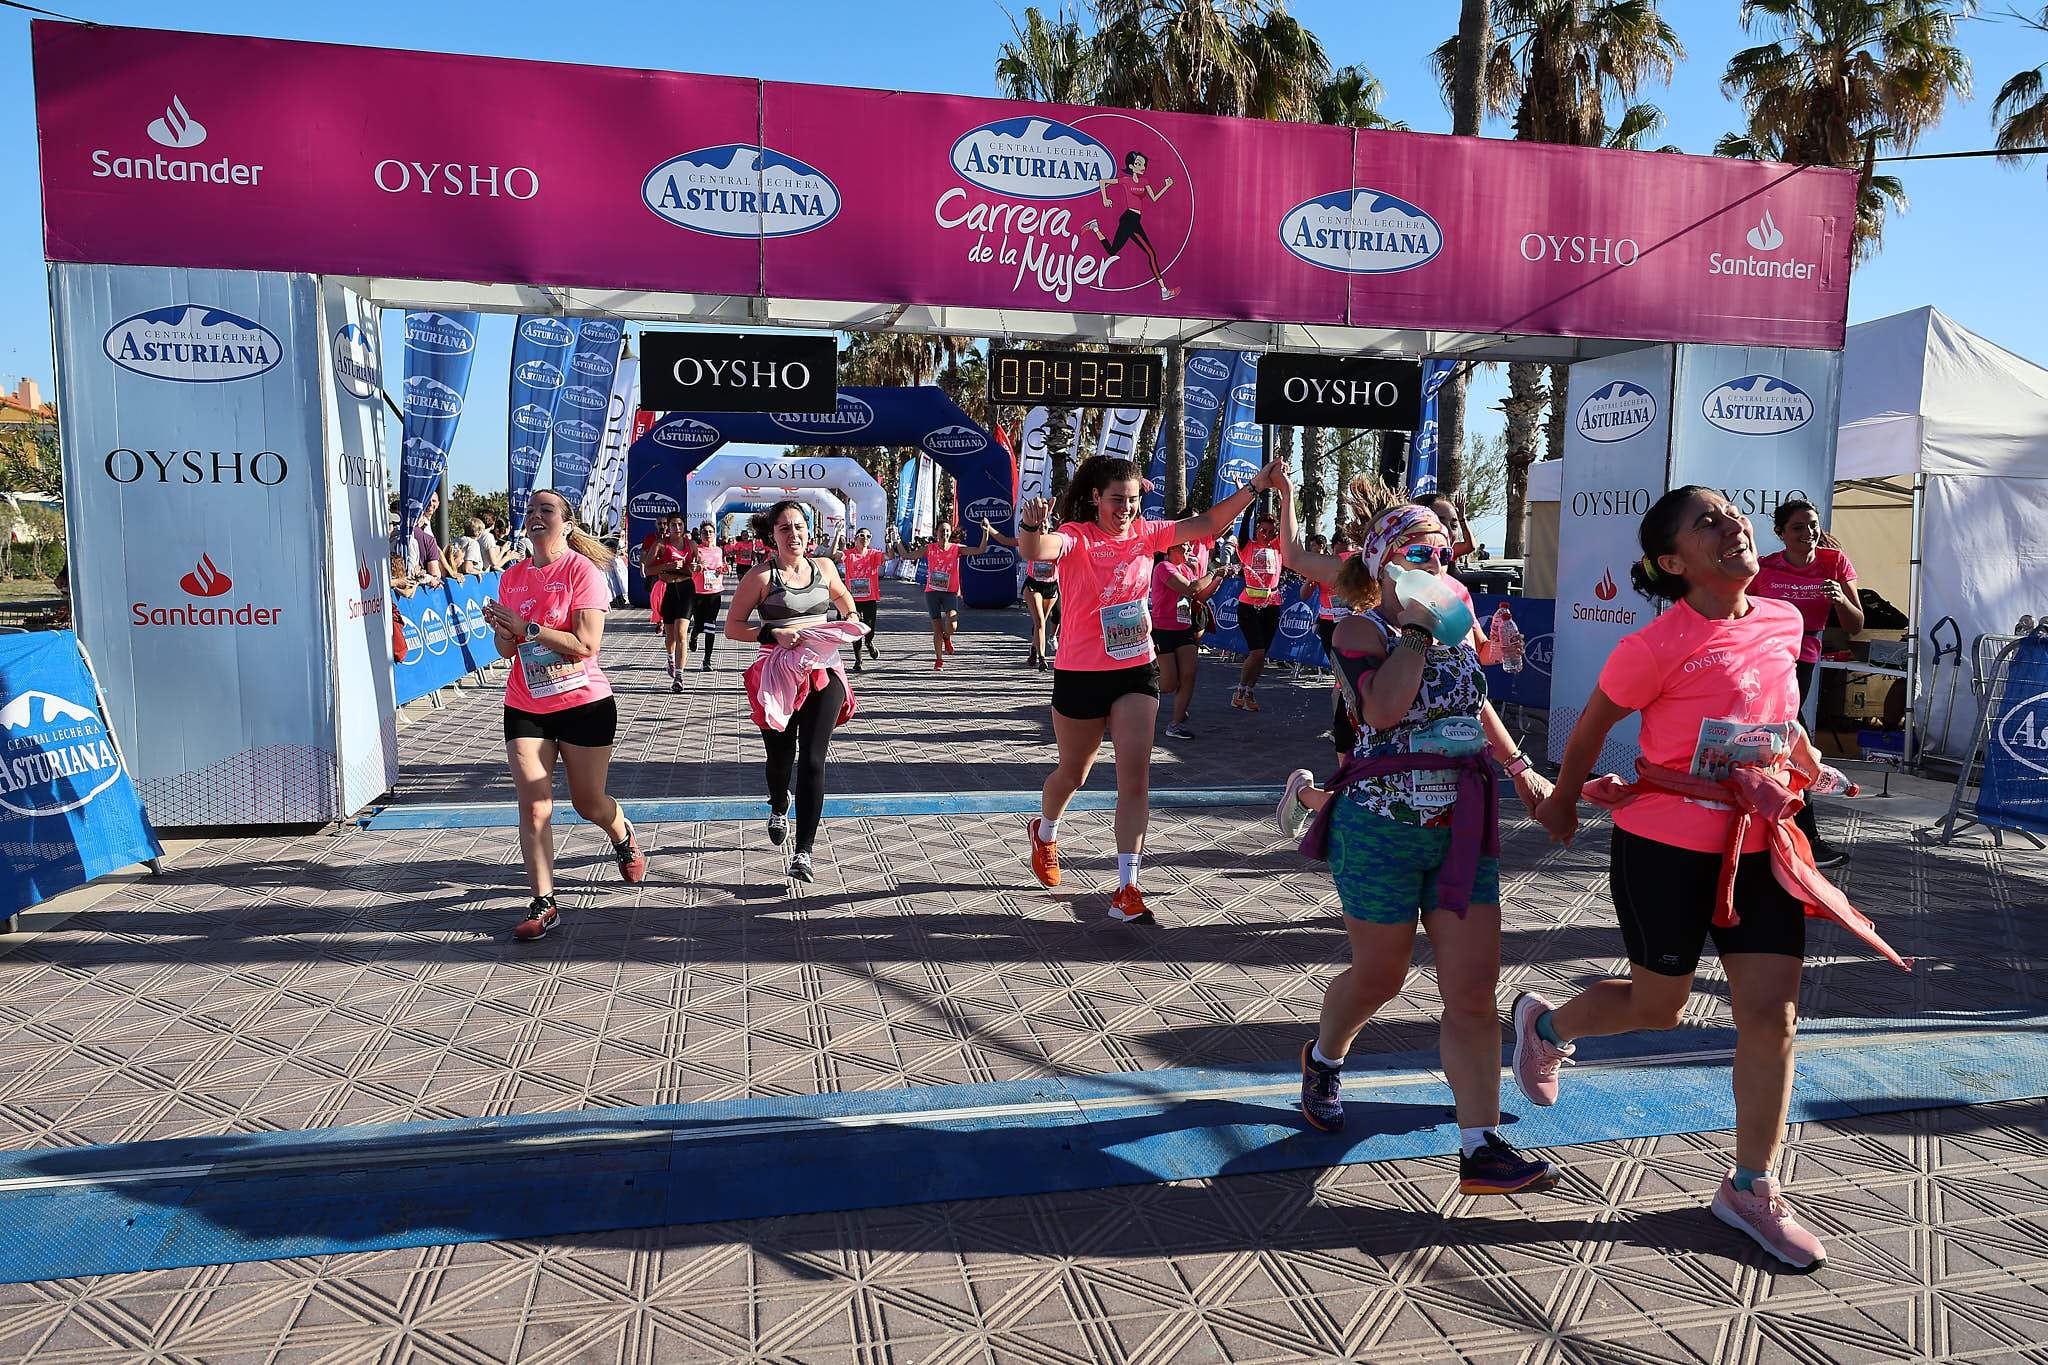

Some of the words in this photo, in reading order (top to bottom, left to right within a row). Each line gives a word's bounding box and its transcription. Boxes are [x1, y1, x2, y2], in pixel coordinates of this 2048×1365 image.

[963, 141, 1101, 182] ASTURIANA
[989, 142, 1042, 154] CENTRAL
[1047, 147, 1100, 158] LECHERA
[92, 150, 263, 186] Santander
[374, 159, 540, 200] OYSHO
[689, 174, 750, 187] CENTRAL
[658, 174, 826, 217] ASTURIANA
[935, 187, 1073, 238] Carrera
[1318, 215, 1368, 227] CENTRAL
[1374, 219, 1427, 230] LECHERA
[1292, 215, 1431, 255] ASTURIANA
[1520, 232, 1640, 267] OYSHO
[968, 233, 995, 263] de
[999, 235, 1017, 265] la
[1012, 234, 1121, 303] Mujer
[1709, 252, 1816, 280] Santander
[117, 330, 271, 365] ASTURIANA
[144, 329, 202, 341] CENTRAL
[206, 331, 264, 342] LECHERA
[337, 347, 377, 385] ASTURIANA
[673, 357, 810, 390] OYSHO
[1000, 359, 1149, 398] 00:43:21
[1184, 391, 1215, 408] STURIANA
[1283, 376, 1399, 407] OYSHO
[1580, 407, 1650, 431] ASTURIANA
[1709, 395, 1805, 422] ASTURIANA
[657, 429, 715, 443] ASTURIANA
[927, 436, 984, 449] ASTURIANA
[104, 448, 288, 486] OYSHO
[339, 453, 382, 489] OYSHO
[744, 462, 826, 480] OYSHO
[1572, 488, 1650, 517] OYSHO
[133, 603, 282, 627] Santander
[1572, 602, 1637, 625] Santander
[7, 733, 51, 751] CENTRAL
[52, 724, 101, 742] LECHERA
